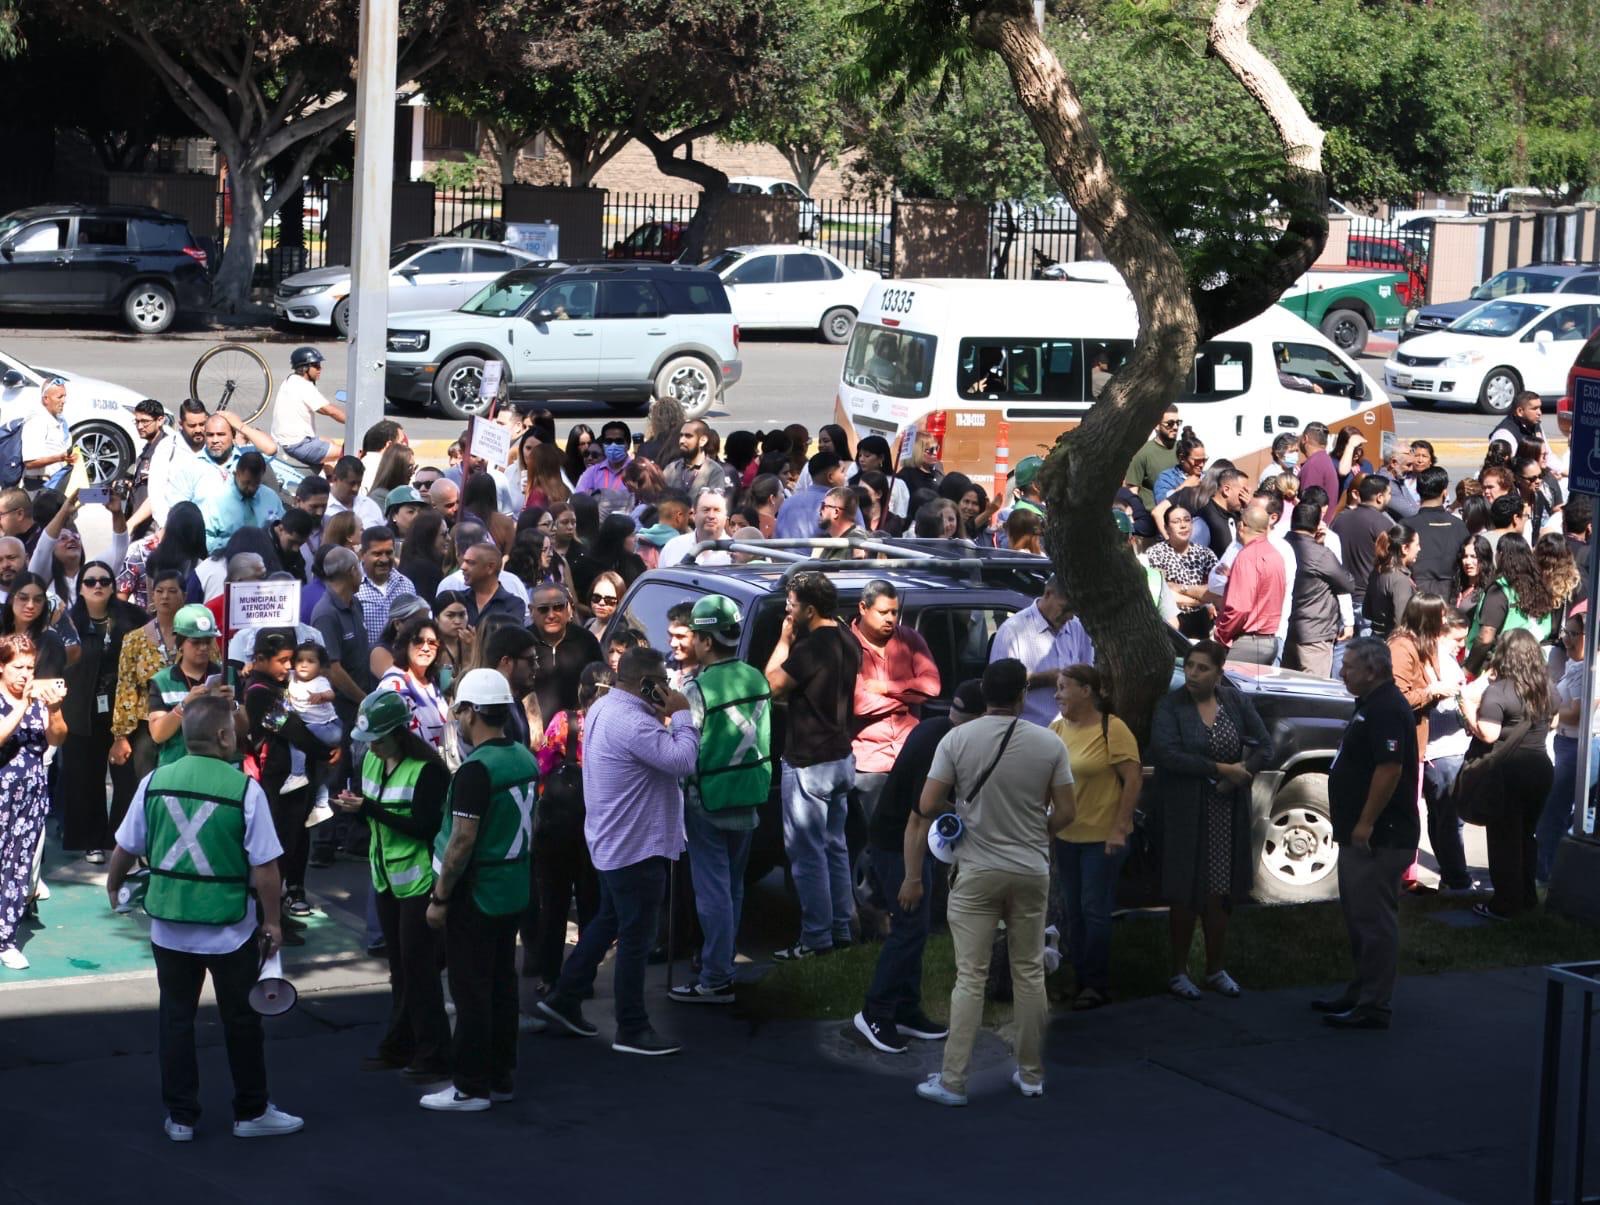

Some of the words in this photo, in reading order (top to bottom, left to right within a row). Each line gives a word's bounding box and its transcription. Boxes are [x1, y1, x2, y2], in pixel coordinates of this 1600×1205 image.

[881, 288, 915, 314] 13335
[240, 596, 277, 604] MUNICIPAL
[241, 603, 275, 611] ATENCIÓN
[246, 611, 280, 619] MIGRANTE
